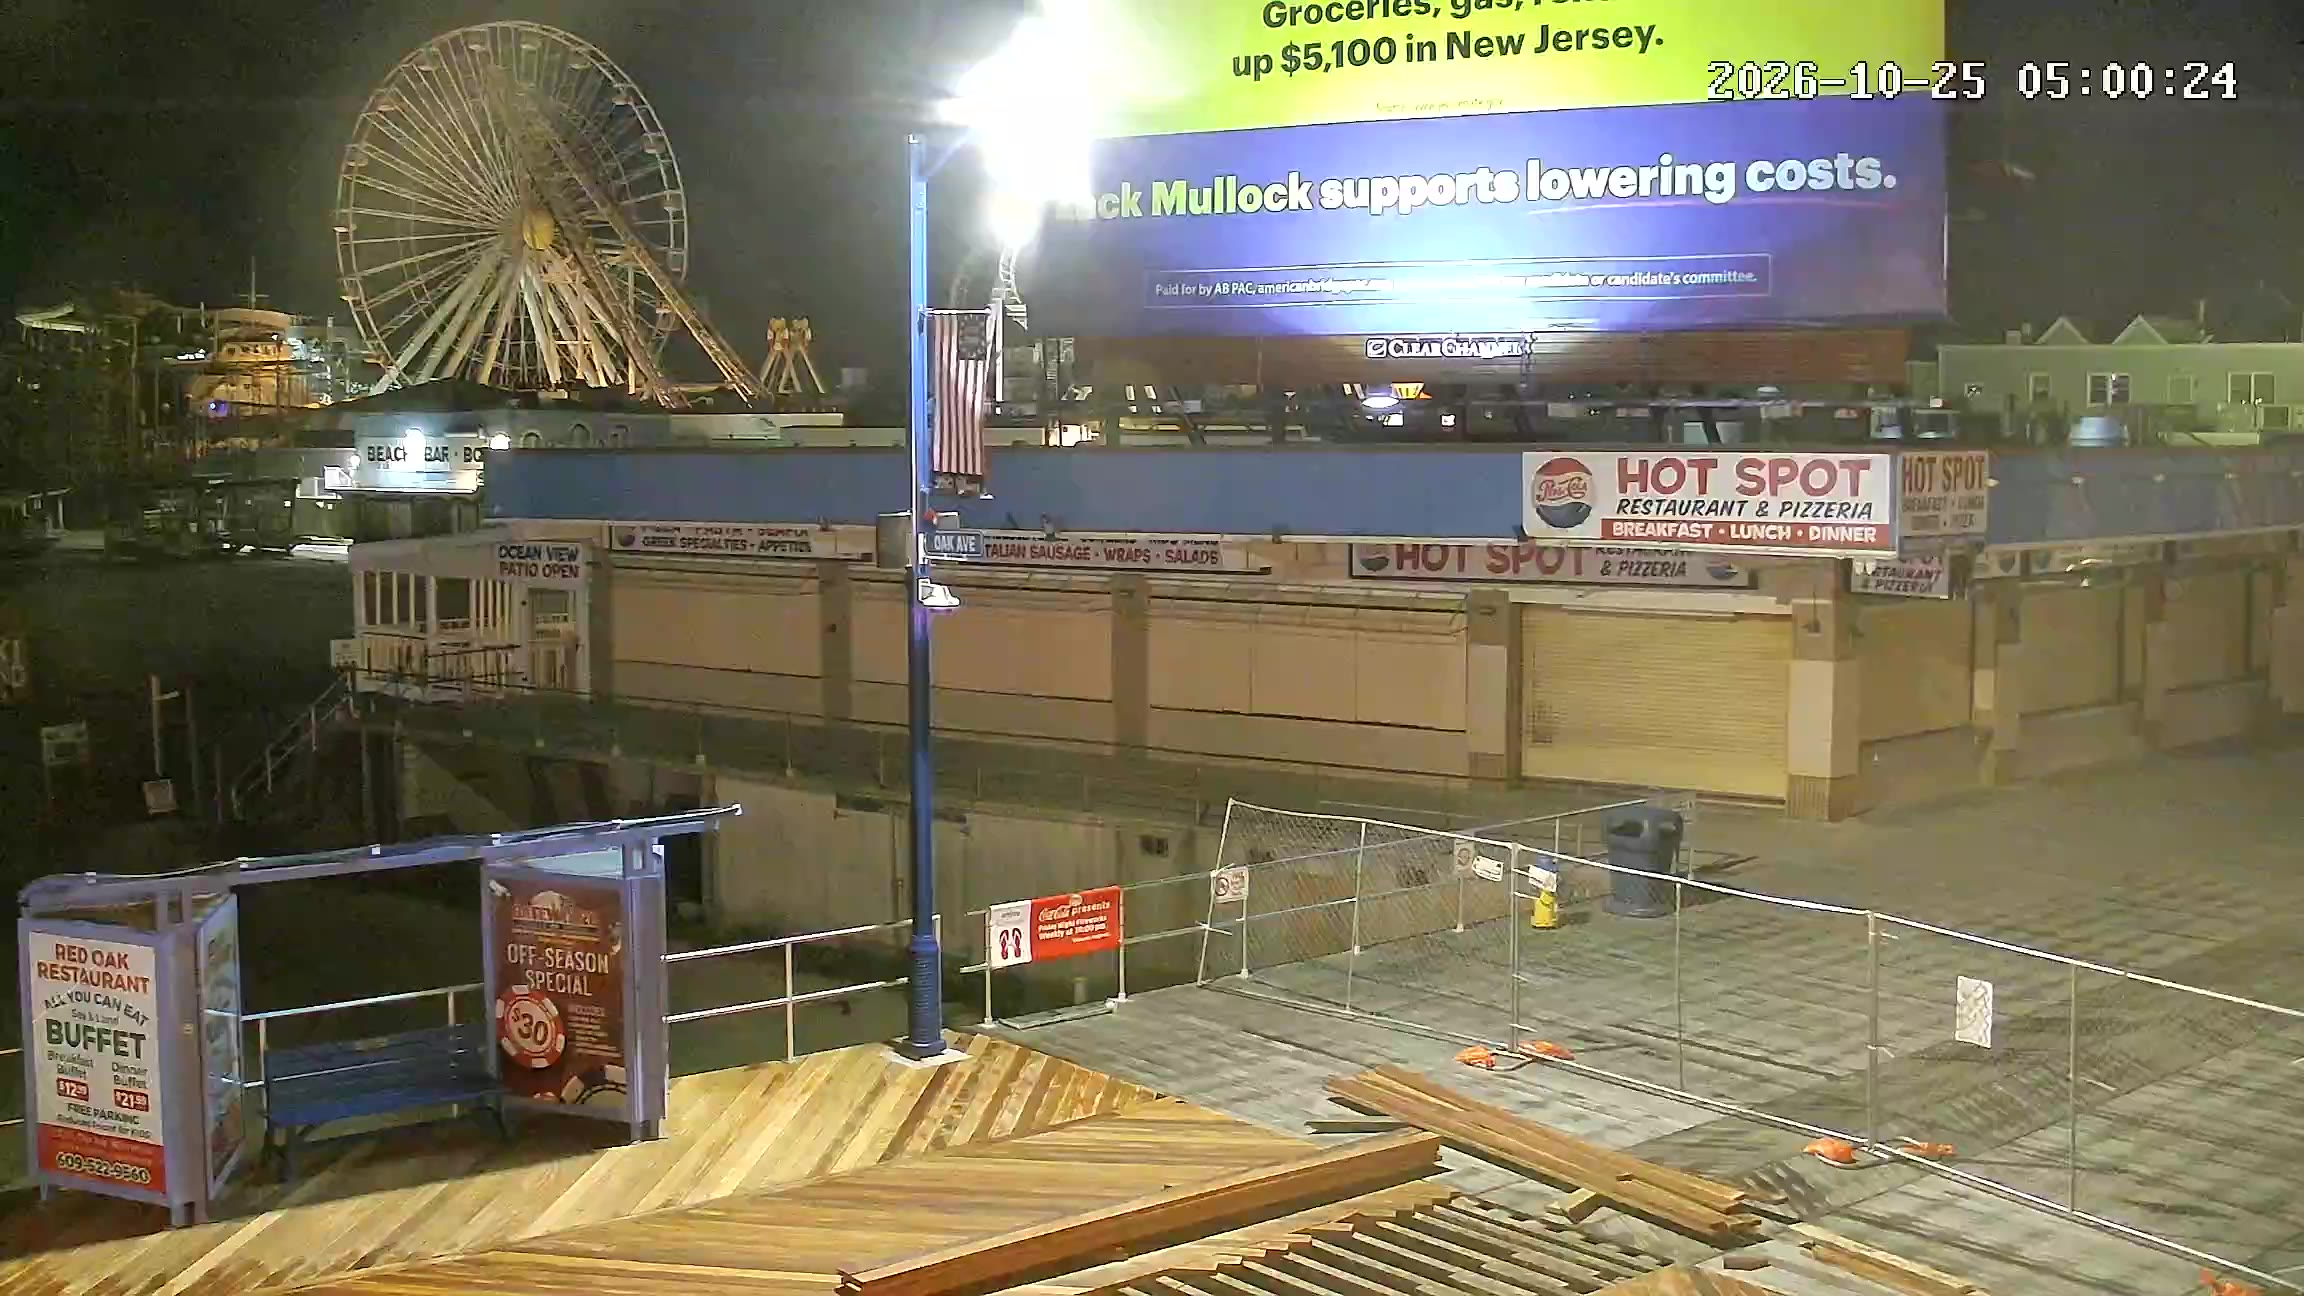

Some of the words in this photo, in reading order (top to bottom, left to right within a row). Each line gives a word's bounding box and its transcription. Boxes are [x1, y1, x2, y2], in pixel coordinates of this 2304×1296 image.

[1262, 0, 1440, 28] Groceries,
[1232, 51, 1273, 81] up
[1280, 37, 1397, 78] $5,100
[1405, 33, 1437, 63] in
[1446, 30, 1526, 61] New
[1534, 24, 1665, 54] Jersey.
[1151, 170, 1314, 217] Mullock
[1318, 165, 1520, 216] supports
[1525, 153, 1737, 204] lowering
[1745, 153, 1897, 193] costs.
[1155, 282, 1179, 295] Paid
[1181, 282, 1197, 295] for
[1199, 283, 1213, 299] by
[1214, 282, 1230, 295] AB
[1231, 281, 1256, 297] PAC,
[1682, 270, 1758, 285] committee.
[424, 446, 449, 462] BAR
[1616, 456, 1719, 497] HOT
[1735, 456, 1872, 498] SPOT
[1902, 455, 1937, 493] HOT
[1942, 454, 1985, 492] SPOT
[1616, 498, 1750, 518] RESTAURANT
[1755, 500, 1770, 518] &
[1778, 500, 1874, 520] PIZZERIA
[934, 535, 954, 552] OAK
[956, 535, 977, 553] AVE
[1612, 519, 1713, 538] BREAKFAST
[1730, 523, 1792, 540] LUNCH
[1808, 525, 1877, 543] DINNER
[497, 543, 543, 562] OCEAN
[545, 545, 579, 563] VIEW
[984, 543, 1027, 560] TALIAN
[1029, 543, 1091, 562] SAUSAGE
[1103, 547, 1151, 565] WRAPS
[1165, 550, 1219, 566] SALADS
[1395, 544, 1469, 574] HOT
[1485, 541, 1594, 577] SPOT
[499, 561, 539, 579] PATIO
[541, 562, 580, 580] OPEN
[1616, 559, 1688, 578] PIZZERIA
[1070, 900, 1111, 917] presents
[55, 943, 88, 965] RED
[91, 949, 130, 971] OAK
[507, 942, 610, 974] OFF-SEASON
[37, 961, 151, 994] RESTAURANT
[524, 969, 593, 997] SPECIAL
[66, 990, 92, 1004] YOU
[93, 993, 122, 1012] CAN
[123, 1003, 150, 1027] EAT
[45, 1018, 147, 1060] BUFFET
